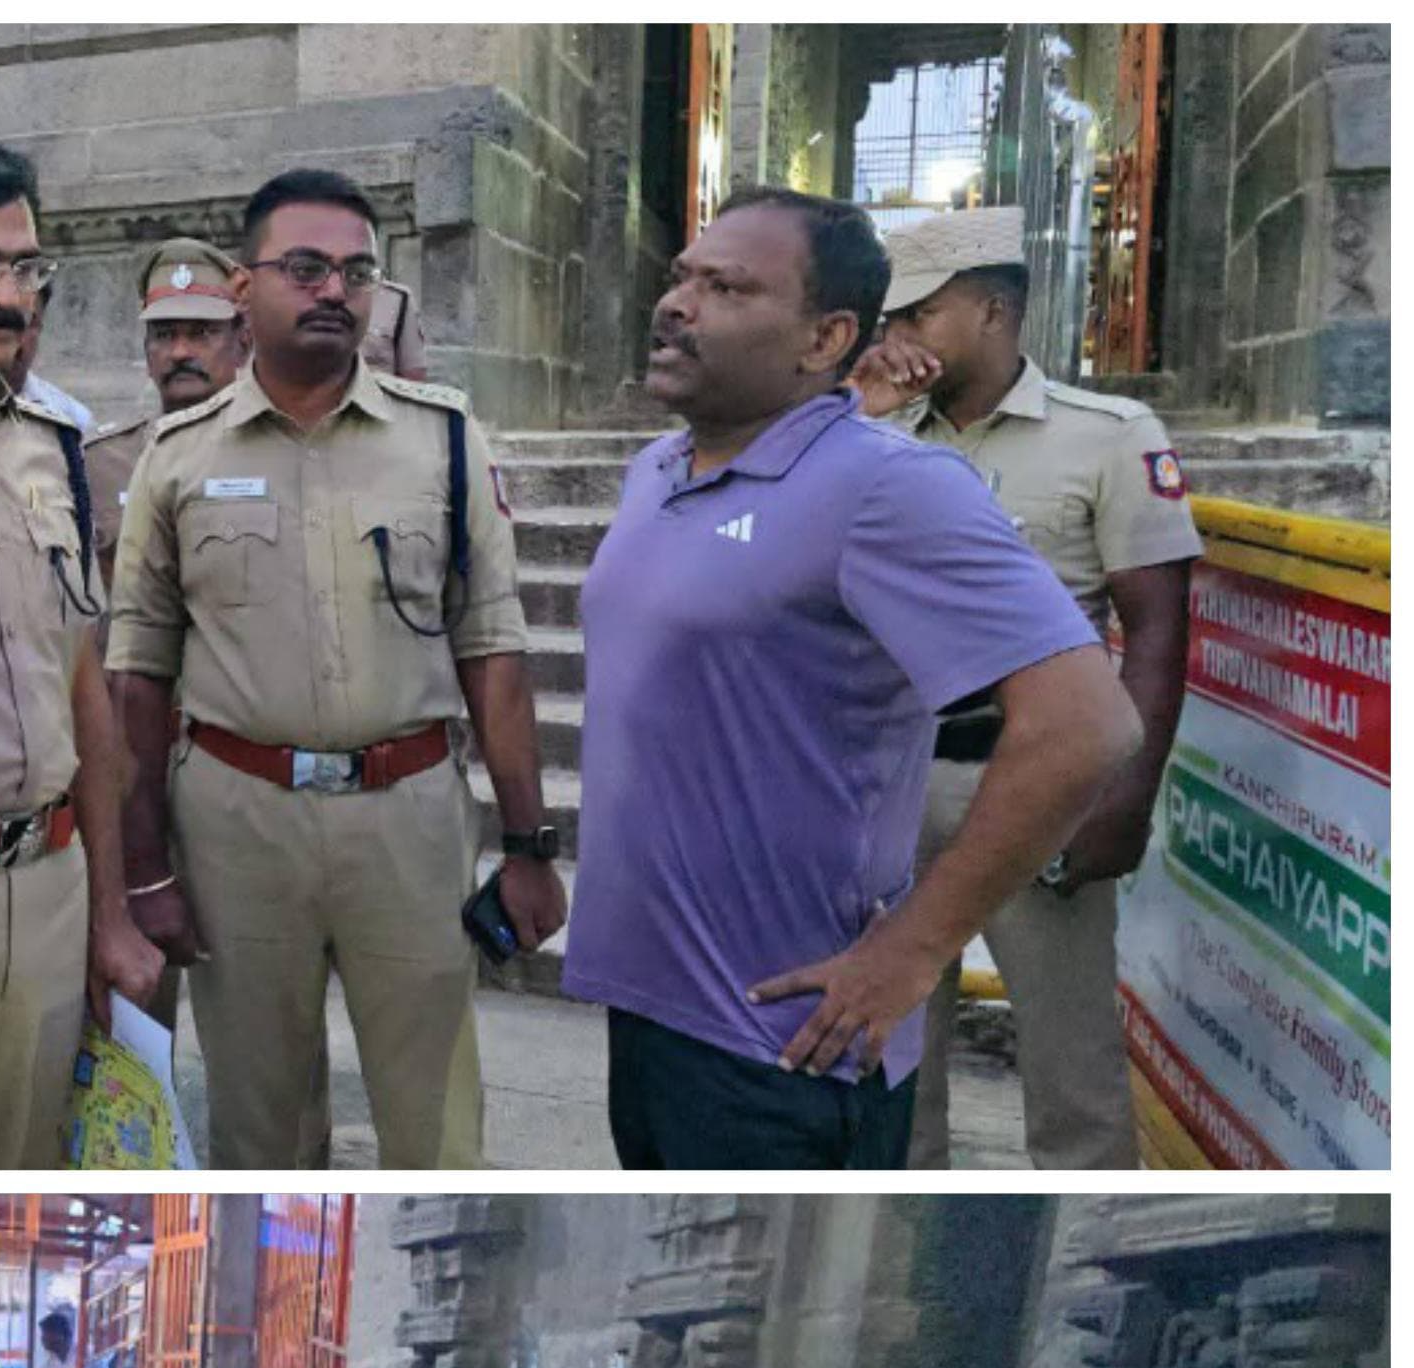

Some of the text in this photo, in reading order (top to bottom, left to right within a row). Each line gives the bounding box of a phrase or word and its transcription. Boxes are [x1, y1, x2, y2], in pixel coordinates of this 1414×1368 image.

[1168, 783, 1391, 977] PACHAIYAPP
[1223, 763, 1379, 874] KANCHIPURAM
[1217, 943, 1288, 1032] Complete
[1290, 1006, 1345, 1096] Family
